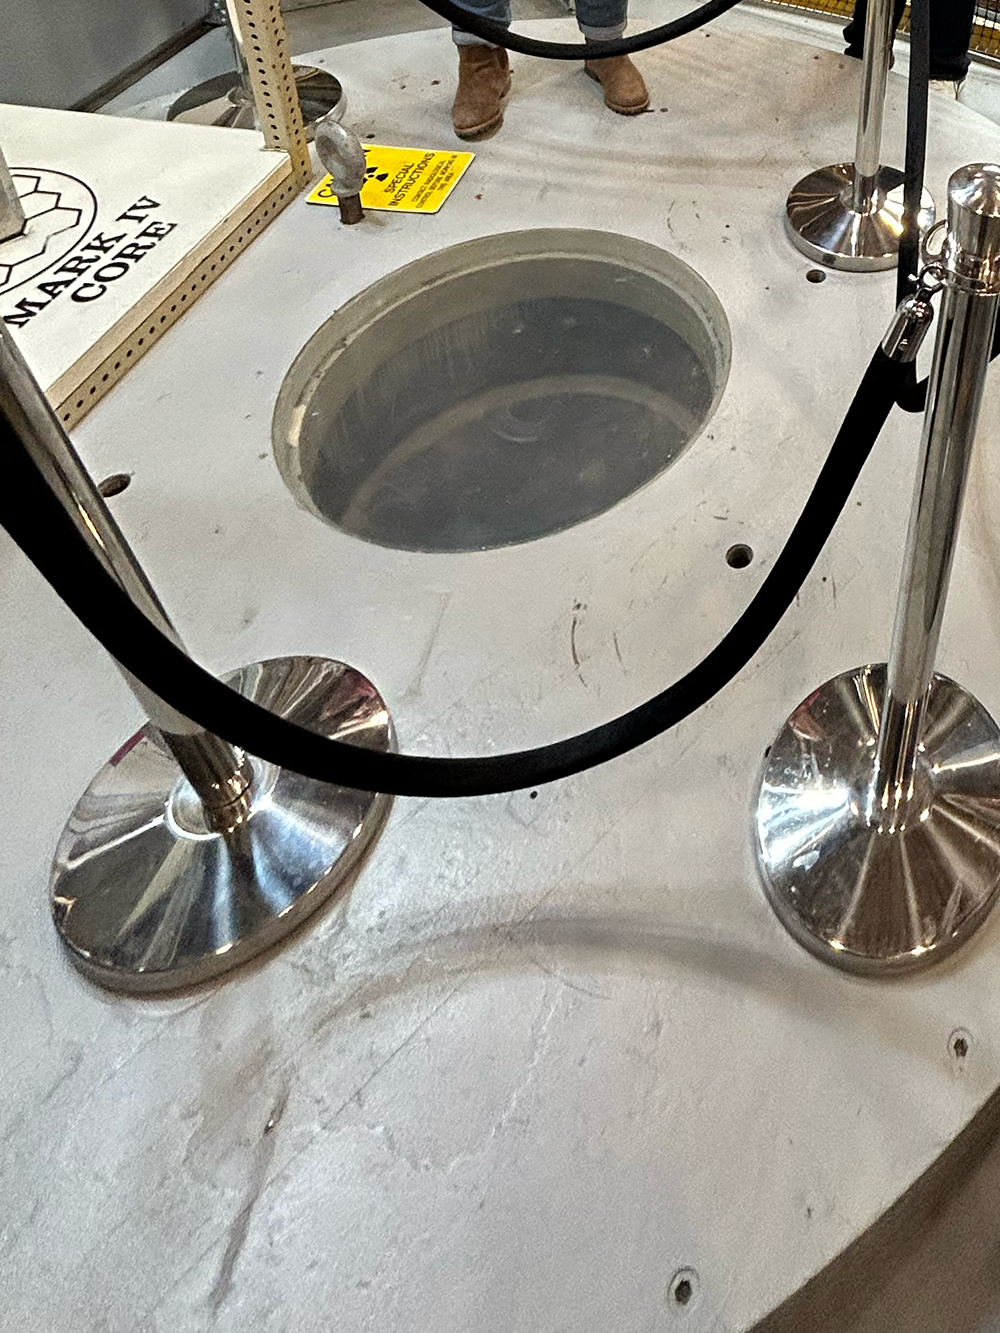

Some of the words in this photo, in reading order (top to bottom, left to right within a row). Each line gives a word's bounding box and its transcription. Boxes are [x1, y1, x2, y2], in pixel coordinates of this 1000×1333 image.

[384, 163, 415, 194] SPECIAL
[388, 152, 435, 207] INSTRUCTIONS
[2, 232, 129, 328] MARK
[115, 195, 162, 223] IV
[71, 221, 178, 302] CORE
